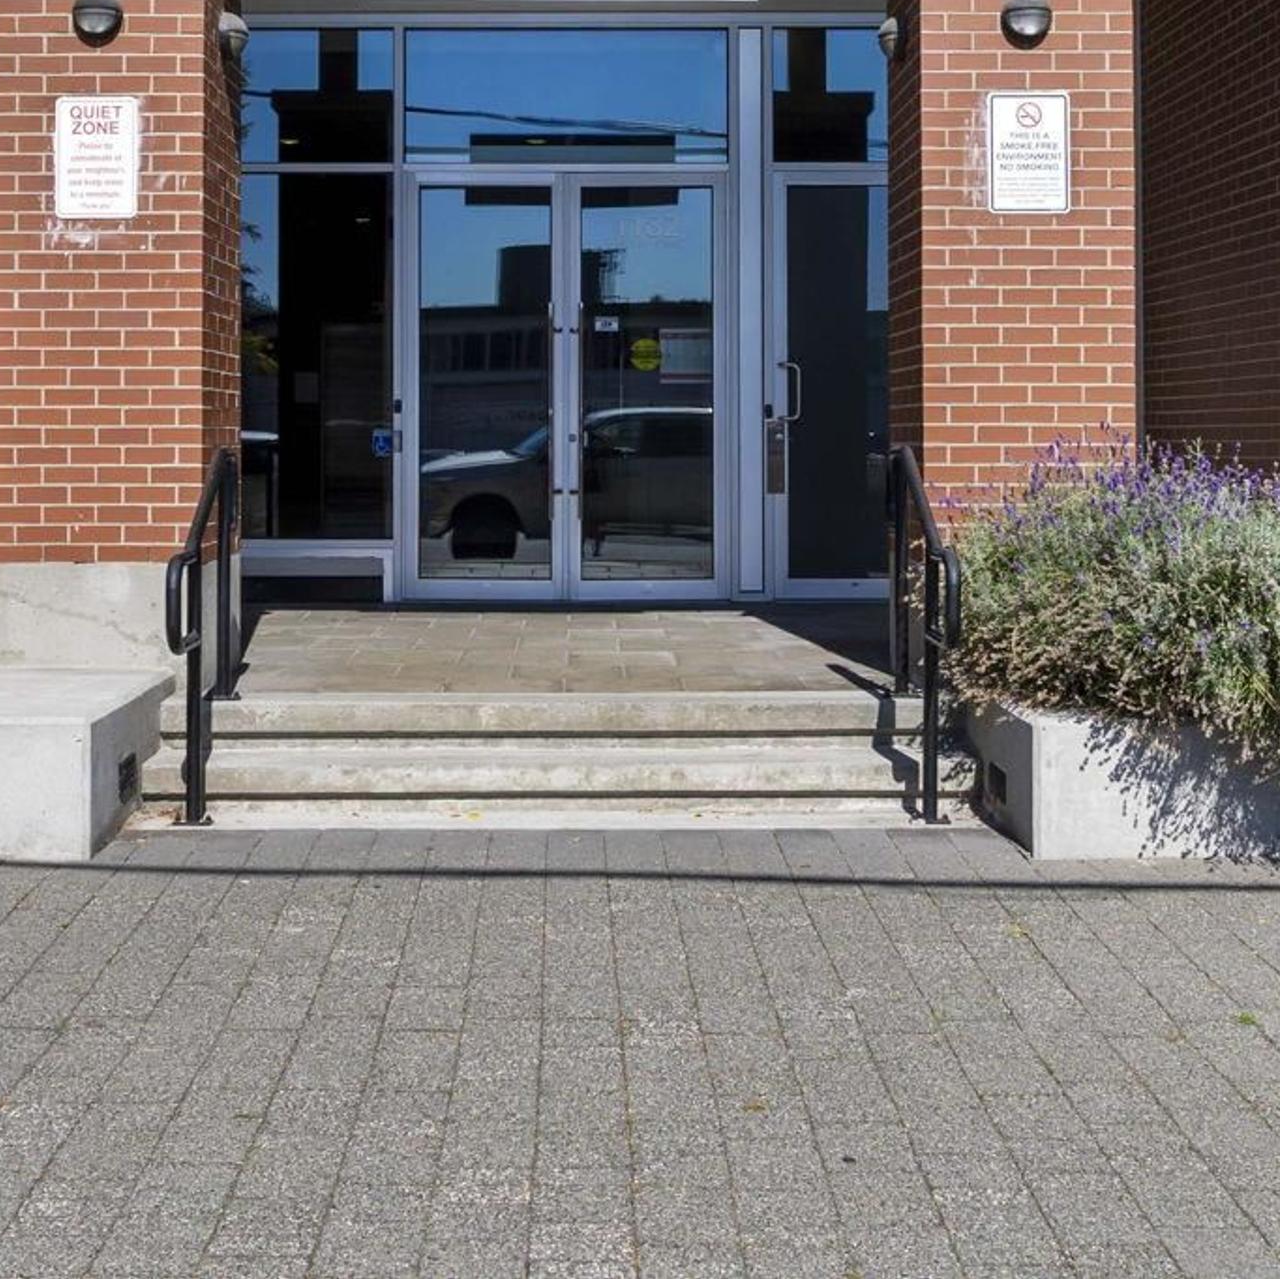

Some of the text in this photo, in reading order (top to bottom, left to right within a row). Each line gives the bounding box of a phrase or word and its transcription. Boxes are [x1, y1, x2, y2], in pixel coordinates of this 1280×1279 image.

[70, 105, 123, 119] QUIET
[71, 121, 120, 135] ZONE
[996, 152, 1062, 161] ENVIRONMENT
[1000, 163, 1059, 171] NO SMOKING
